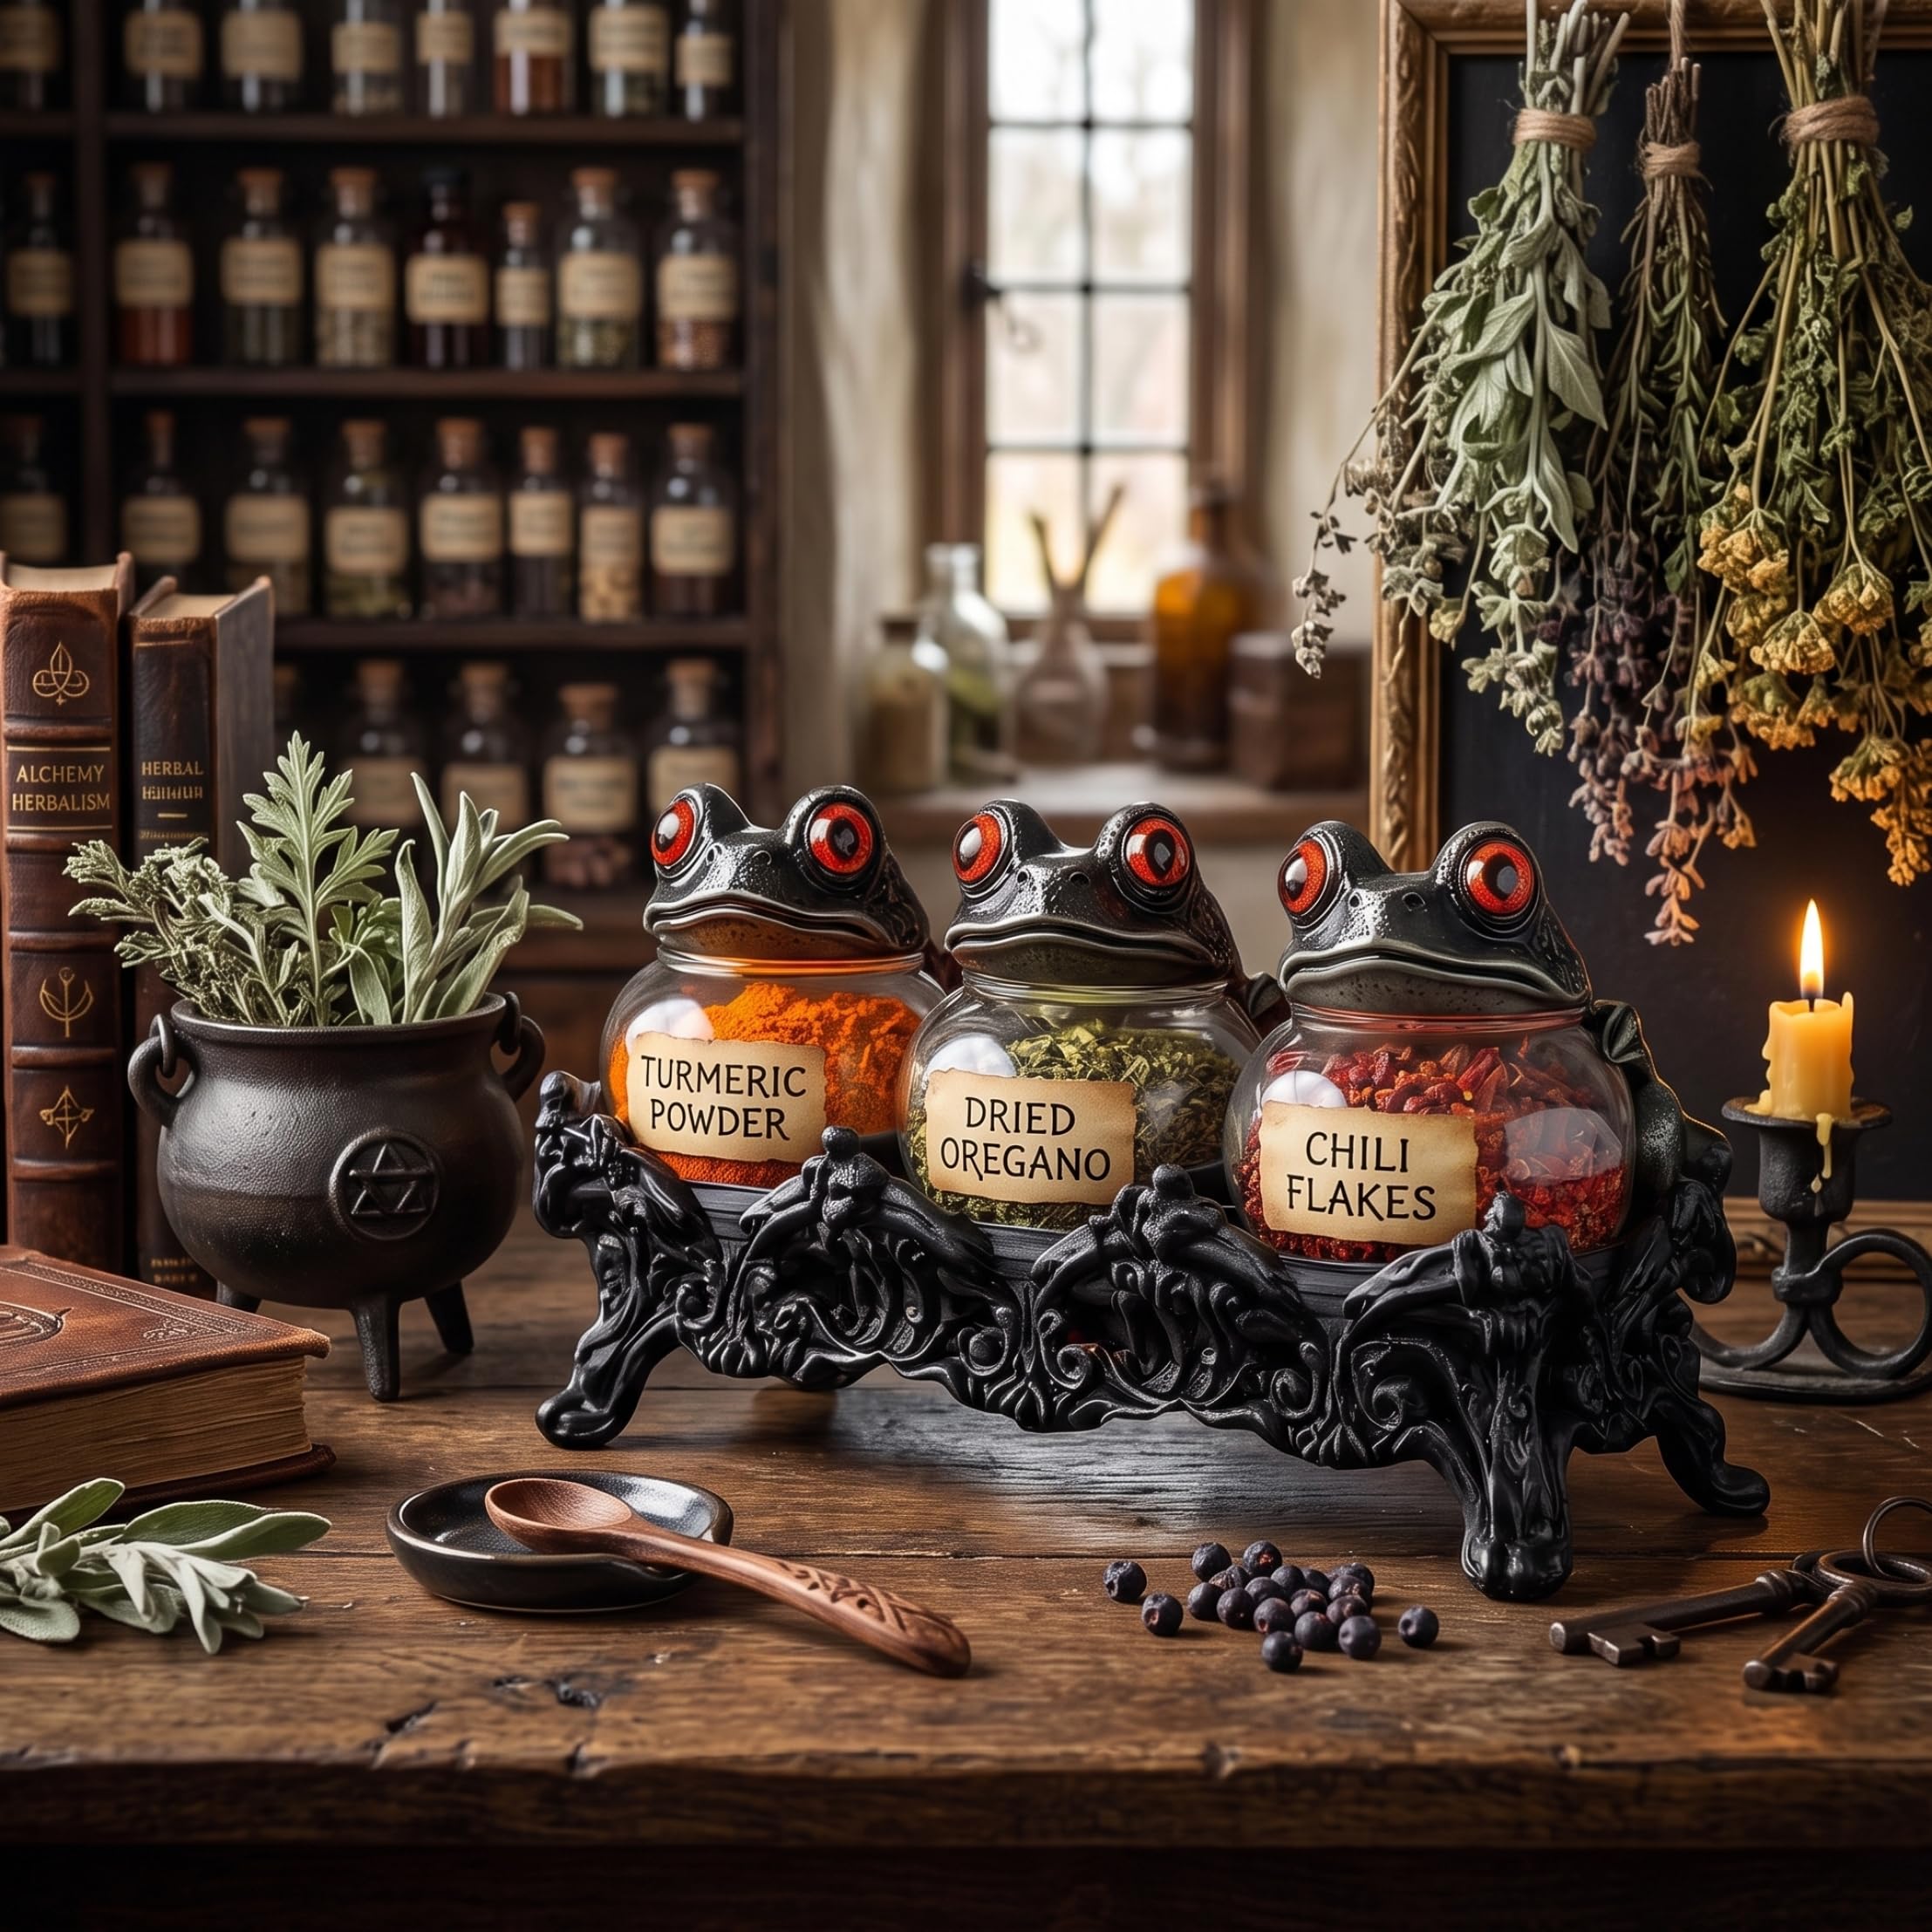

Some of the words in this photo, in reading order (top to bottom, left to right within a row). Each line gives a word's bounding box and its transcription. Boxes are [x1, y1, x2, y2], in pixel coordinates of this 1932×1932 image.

[16, 765, 105, 783] ALCHEMY
[141, 761, 204, 776] HERBAL
[11, 794, 111, 812] HERBALISM
[641, 1055, 807, 1099] TURMERIC
[651, 1099, 790, 1141] POWDER
[965, 1096, 1075, 1136] DRIED
[941, 1137, 1111, 1181] OREGANO
[1306, 1131, 1409, 1173] CHILI
[1287, 1174, 1437, 1221] FLAKES
